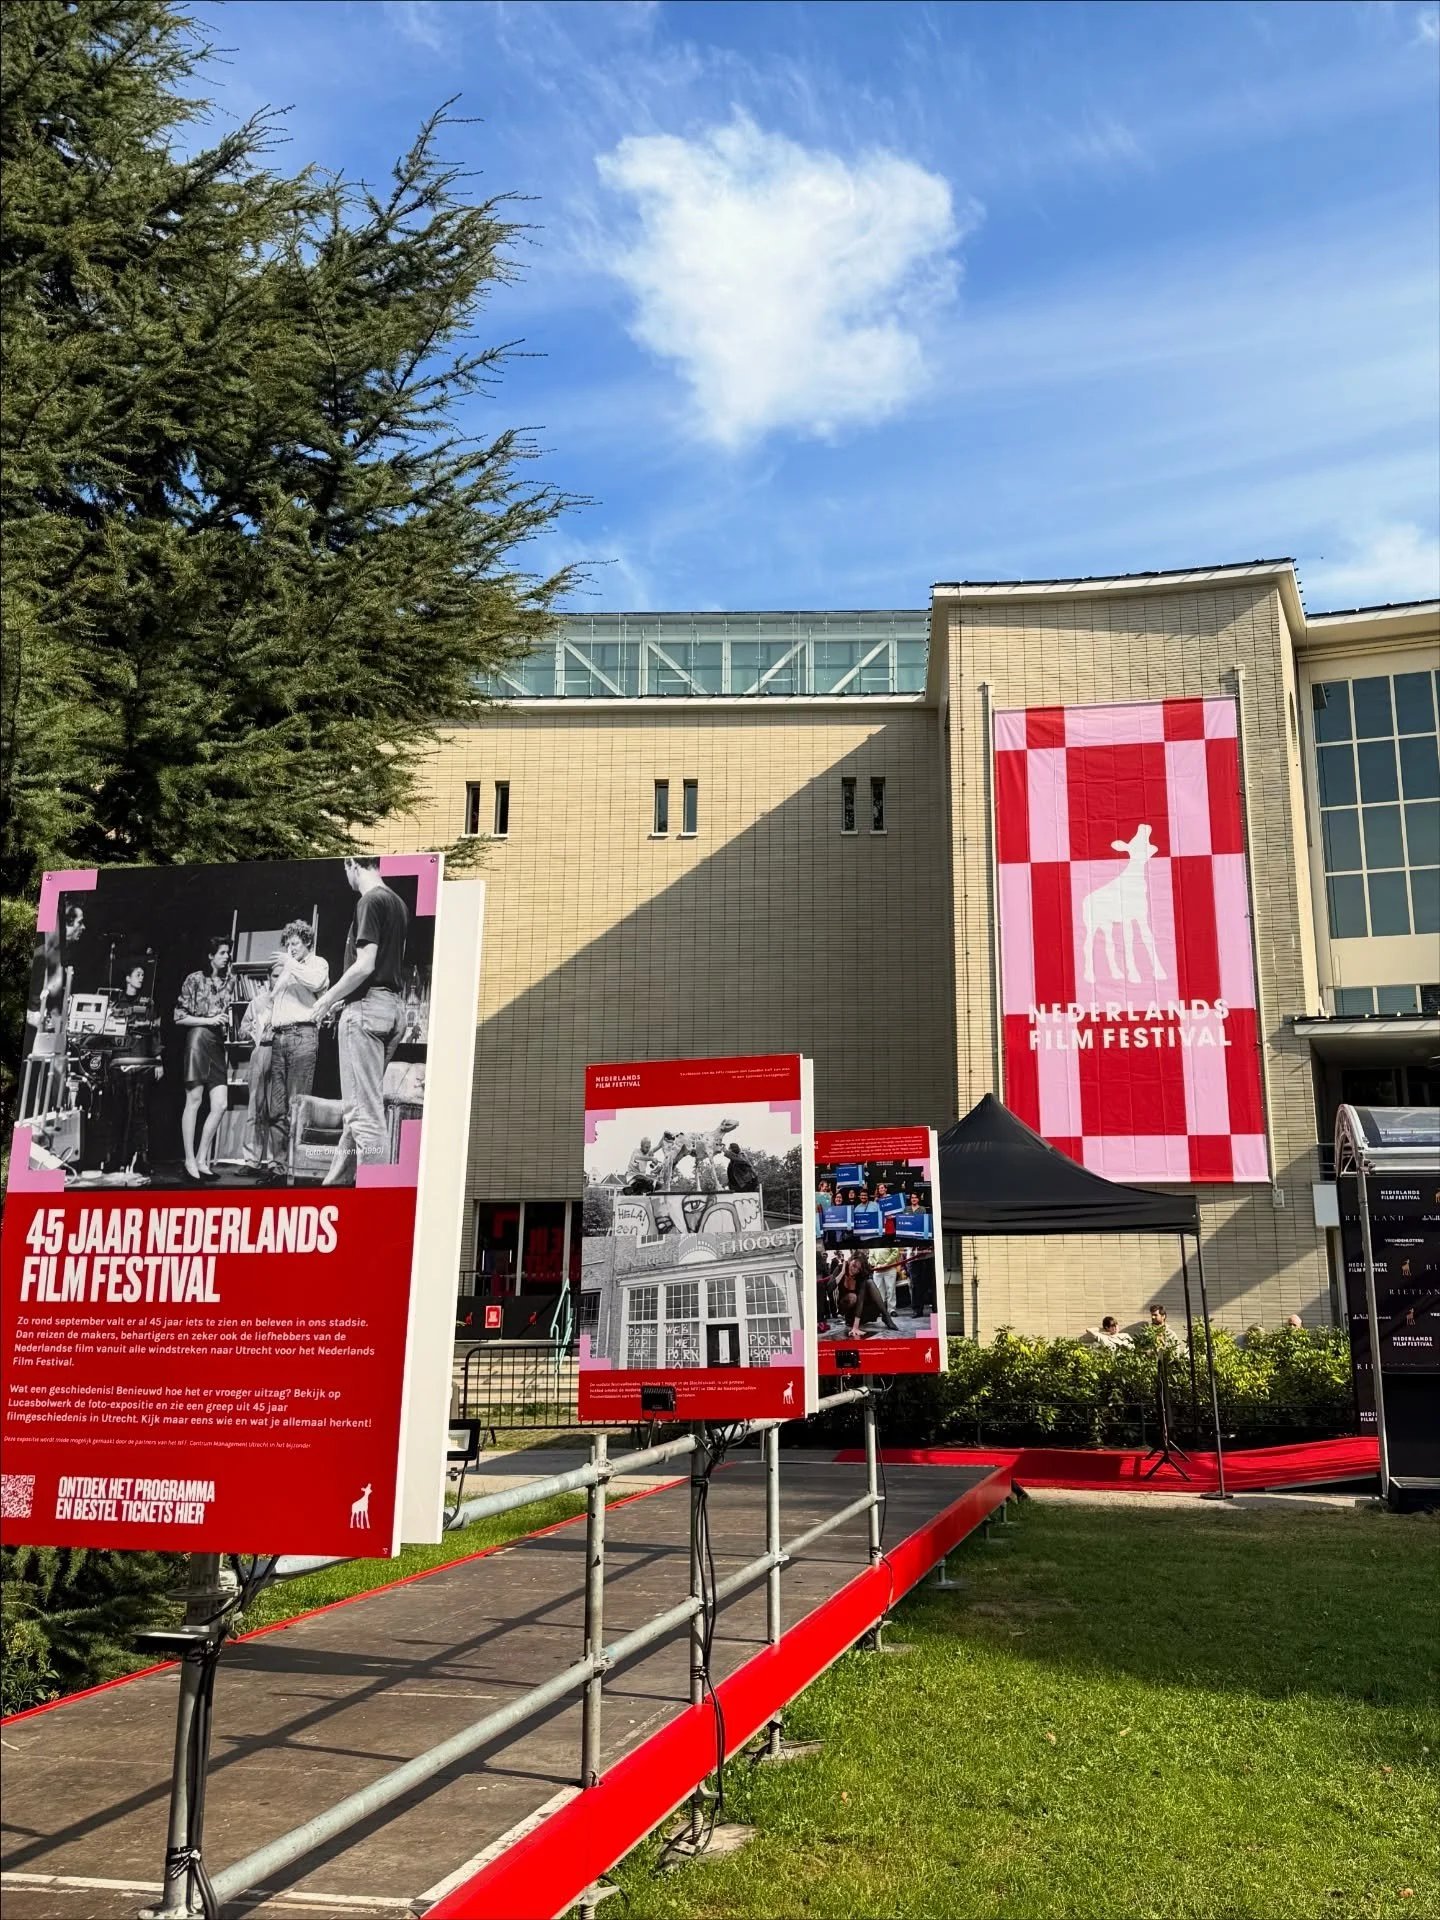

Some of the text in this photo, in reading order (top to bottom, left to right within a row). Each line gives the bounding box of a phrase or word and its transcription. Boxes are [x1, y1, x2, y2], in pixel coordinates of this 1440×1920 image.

[1028, 998, 1229, 1024] NEDERLANDS
[1029, 1026, 1232, 1050] FILM FESTIVAL
[26, 1206, 339, 1254] 45 JAAR NEDERLANDS
[20, 1256, 220, 1302] FILM FESTIVAL
[17, 1317, 29, 1325] Zo
[32, 1317, 52, 1325] rond
[55, 1317, 105, 1327] september
[107, 1317, 125, 1326] valt
[139, 1318, 147, 1326] al
[150, 1318, 161, 1326] 45
[162, 1318, 183, 1328] jaar
[186, 1318, 203, 1327] iets
[206, 1319, 215, 1327] te
[218, 1318, 238, 1327] zien
[255, 1318, 293, 1327] beleven
[296, 1318, 306, 1327] in
[329, 1318, 368, 1327] stadsie.
[16, 1330, 34, 1338] Dan
[36, 1330, 65, 1338] reizen
[67, 1331, 78, 1339] de
[81, 1331, 118, 1341] makers,
[121, 1331, 175, 1342] behartigers
[192, 1332, 218, 1340] zeker
[220, 1332, 238, 1341] ook
[240, 1332, 252, 1341] de
[255, 1332, 311, 1341] liefhebbers
[334, 1332, 347, 1341] de
[14, 1344, 72, 1352] Nederlandse
[75, 1344, 94, 1353] film
[97, 1345, 127, 1353] vanuit
[129, 1345, 146, 1353] alle
[148, 1345, 208, 1354] windstreken
[235, 1346, 272, 1355] Utrecht
[299, 1347, 315, 1355] het
[318, 1347, 375, 1356] Nederlands
[13, 1357, 74, 1366] Film Festival.
[9, 1384, 28, 1393] Wat
[49, 1385, 114, 1396] geschiedenis!
[116, 1386, 162, 1395] Benieuwd
[165, 1387, 182, 1395] hoe
[185, 1387, 200, 1396] het
[215, 1388, 252, 1399] vroeger
[254, 1389, 291, 1400] uitzag?
[294, 1389, 326, 1400] Bekijk
[328, 1391, 341, 1400] op
[8, 1398, 72, 1408] Lucasbolwerk
[74, 1399, 86, 1408] de
[88, 1400, 153, 1411] foto-expositie
[170, 1401, 184, 1410] zie
[206, 1403, 233, 1413] greep
[237, 1403, 250, 1411] uit
[253, 1403, 265, 1412] 45
[267, 1403, 288, 1414] jaar
[7, 1412, 87, 1423] filmgeschiedenis
[90, 1413, 99, 1422] in
[102, 1414, 138, 1423] Utrecht.
[141, 1414, 160, 1426] Kijk
[216, 1417, 233, 1425] wie
[250, 1418, 268, 1426] wat
[269, 1418, 281, 1428] je
[283, 1418, 327, 1426] allemaal
[329, 1418, 372, 1428] herkent!
[57, 1476, 215, 1502] ONTDEK HET PROGRAMMA
[55, 1498, 204, 1524] EN BESTEL TICKETS HIER
